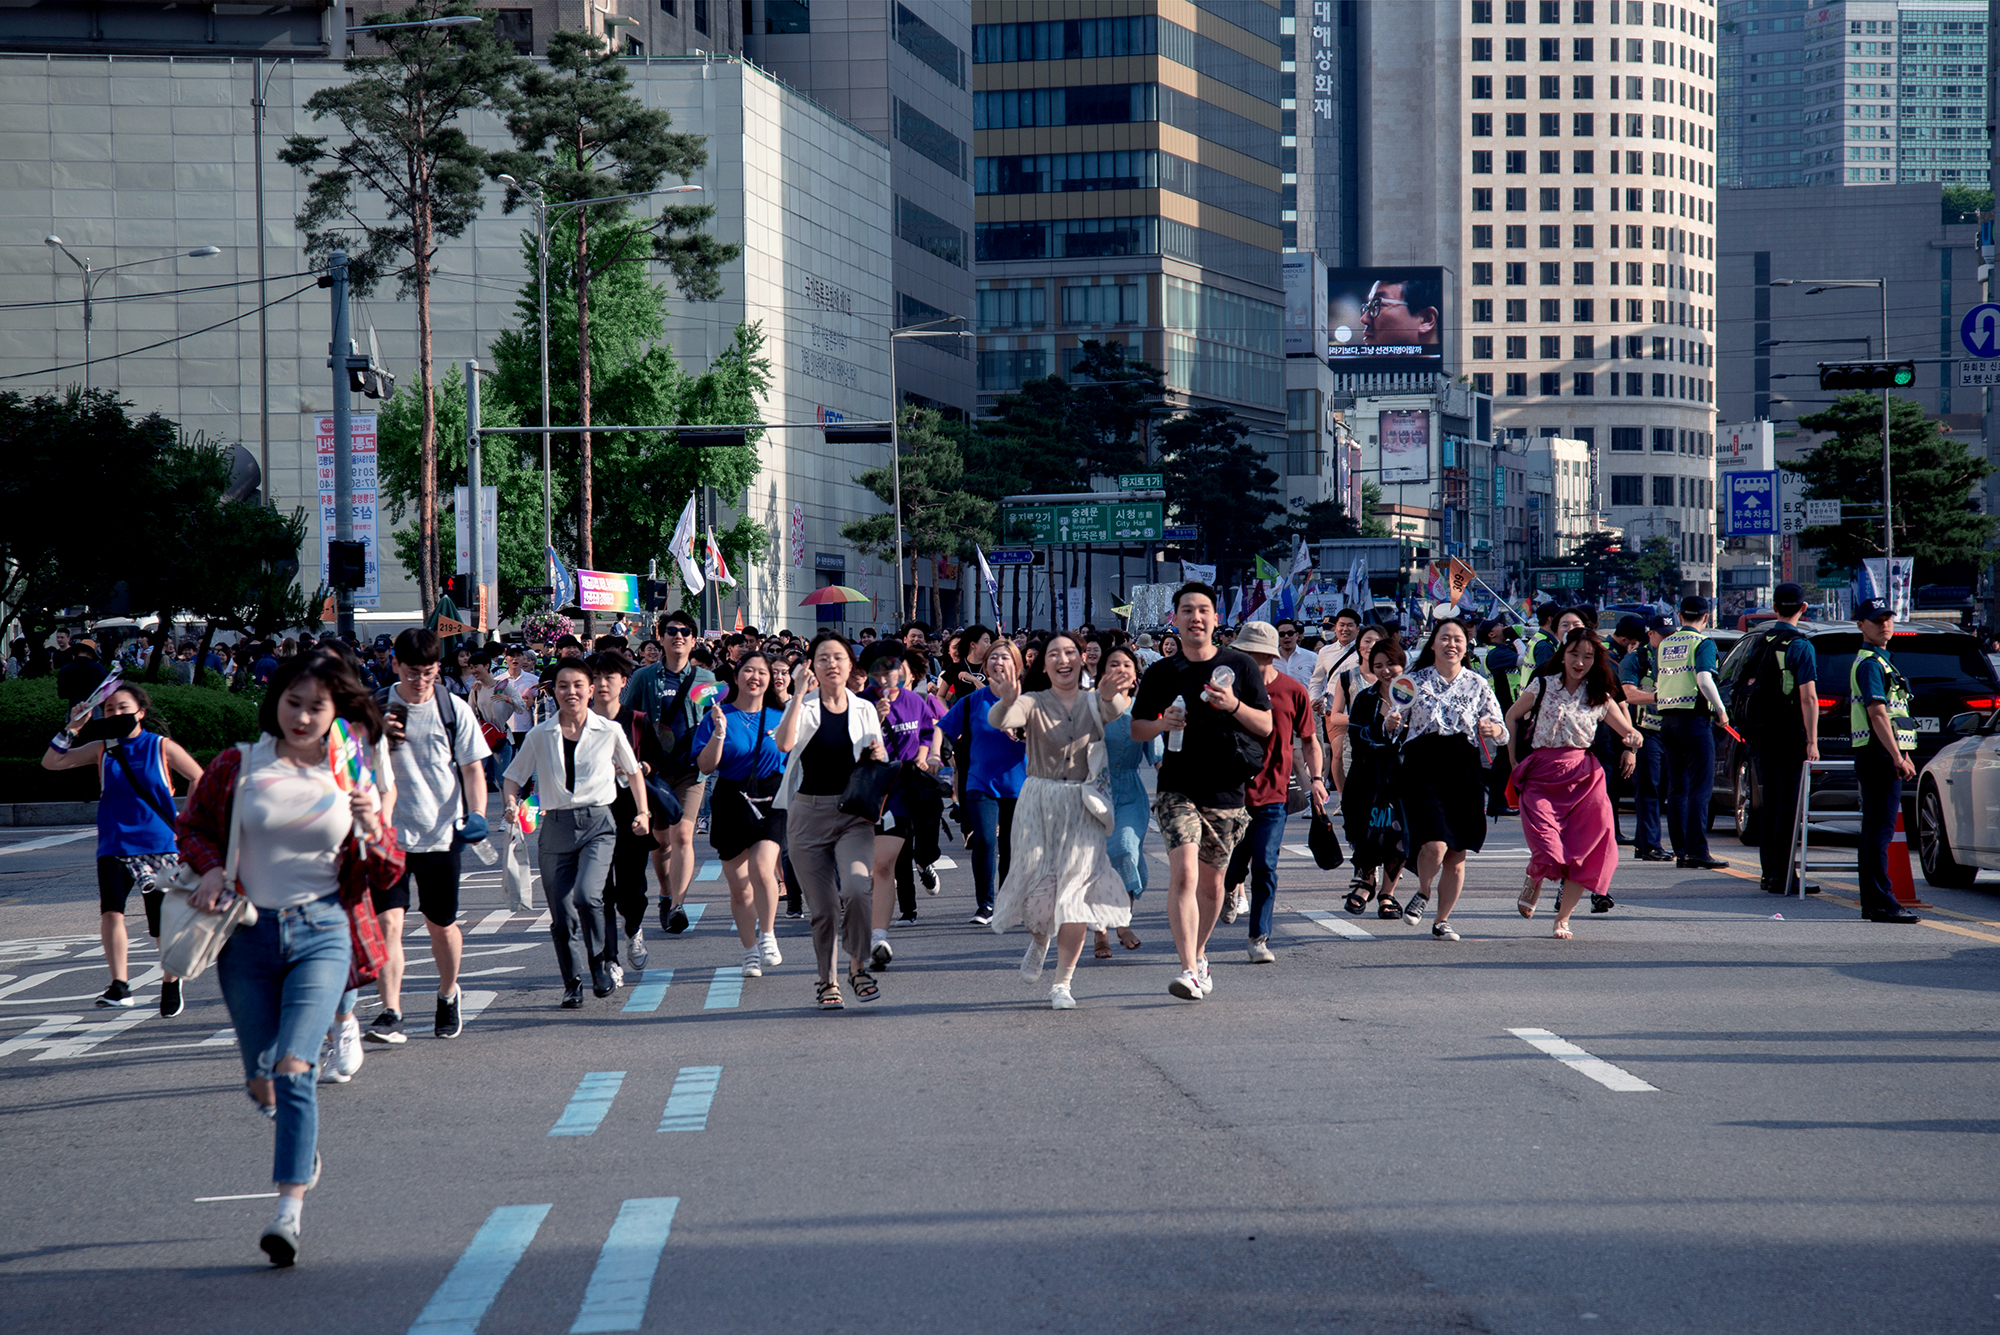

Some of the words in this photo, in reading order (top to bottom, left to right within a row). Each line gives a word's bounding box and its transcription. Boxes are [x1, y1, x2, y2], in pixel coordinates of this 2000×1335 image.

[1360, 346, 1375, 355] 그냥
[1375, 345, 1422, 355] 선견지명이랄까
[1963, 362, 1986, 371] 좌회전
[1990, 362, 2000, 371] 신
[1071, 507, 1098, 517] 숭례문
[1115, 509, 1135, 520] 시청
[1735, 509, 1771, 519] 우측차로
[1116, 520, 1130, 528] City
[1734, 519, 1771, 529] 버스전용
[1072, 530, 1106, 541] 한국은행
[440, 623, 462, 632] 219-2
